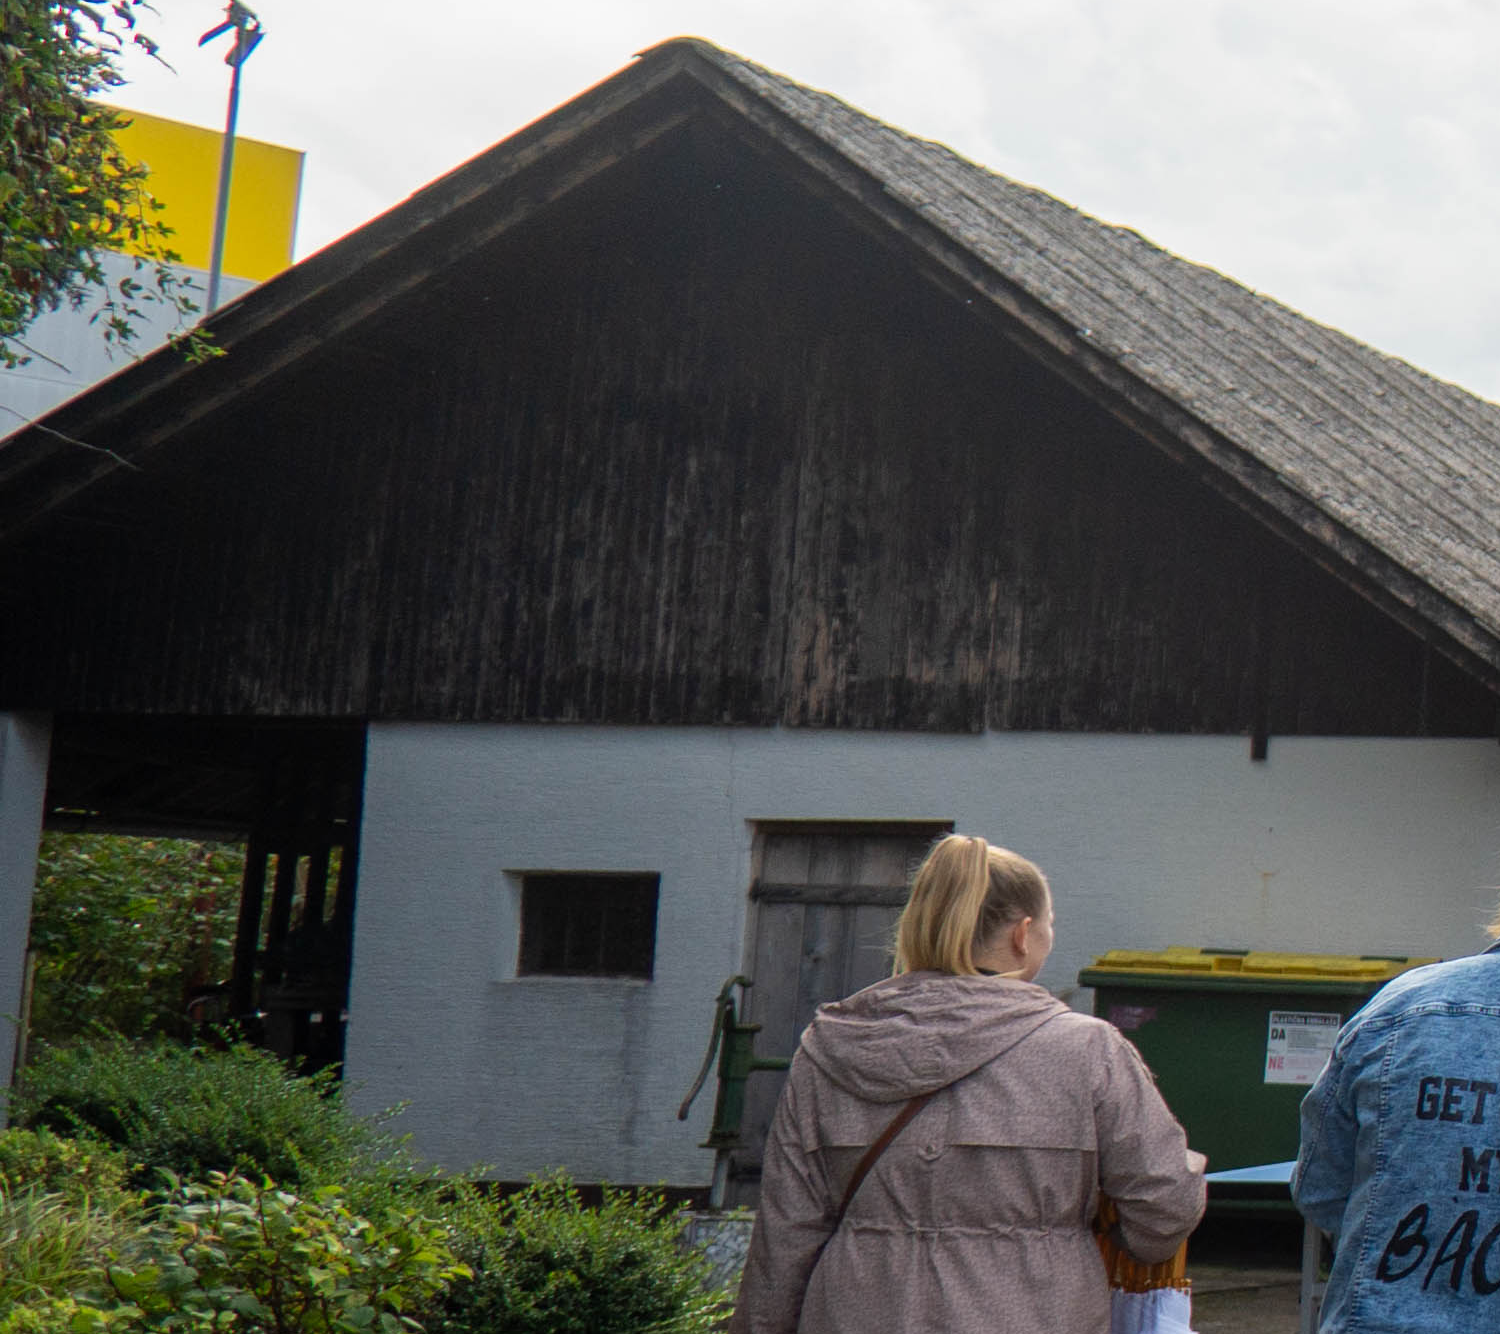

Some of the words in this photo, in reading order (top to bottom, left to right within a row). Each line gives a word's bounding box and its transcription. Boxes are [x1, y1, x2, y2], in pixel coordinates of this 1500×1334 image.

[1271, 1028, 1286, 1040] DA
[1268, 1056, 1284, 1070] NE
[1416, 1076, 1497, 1124] GET
